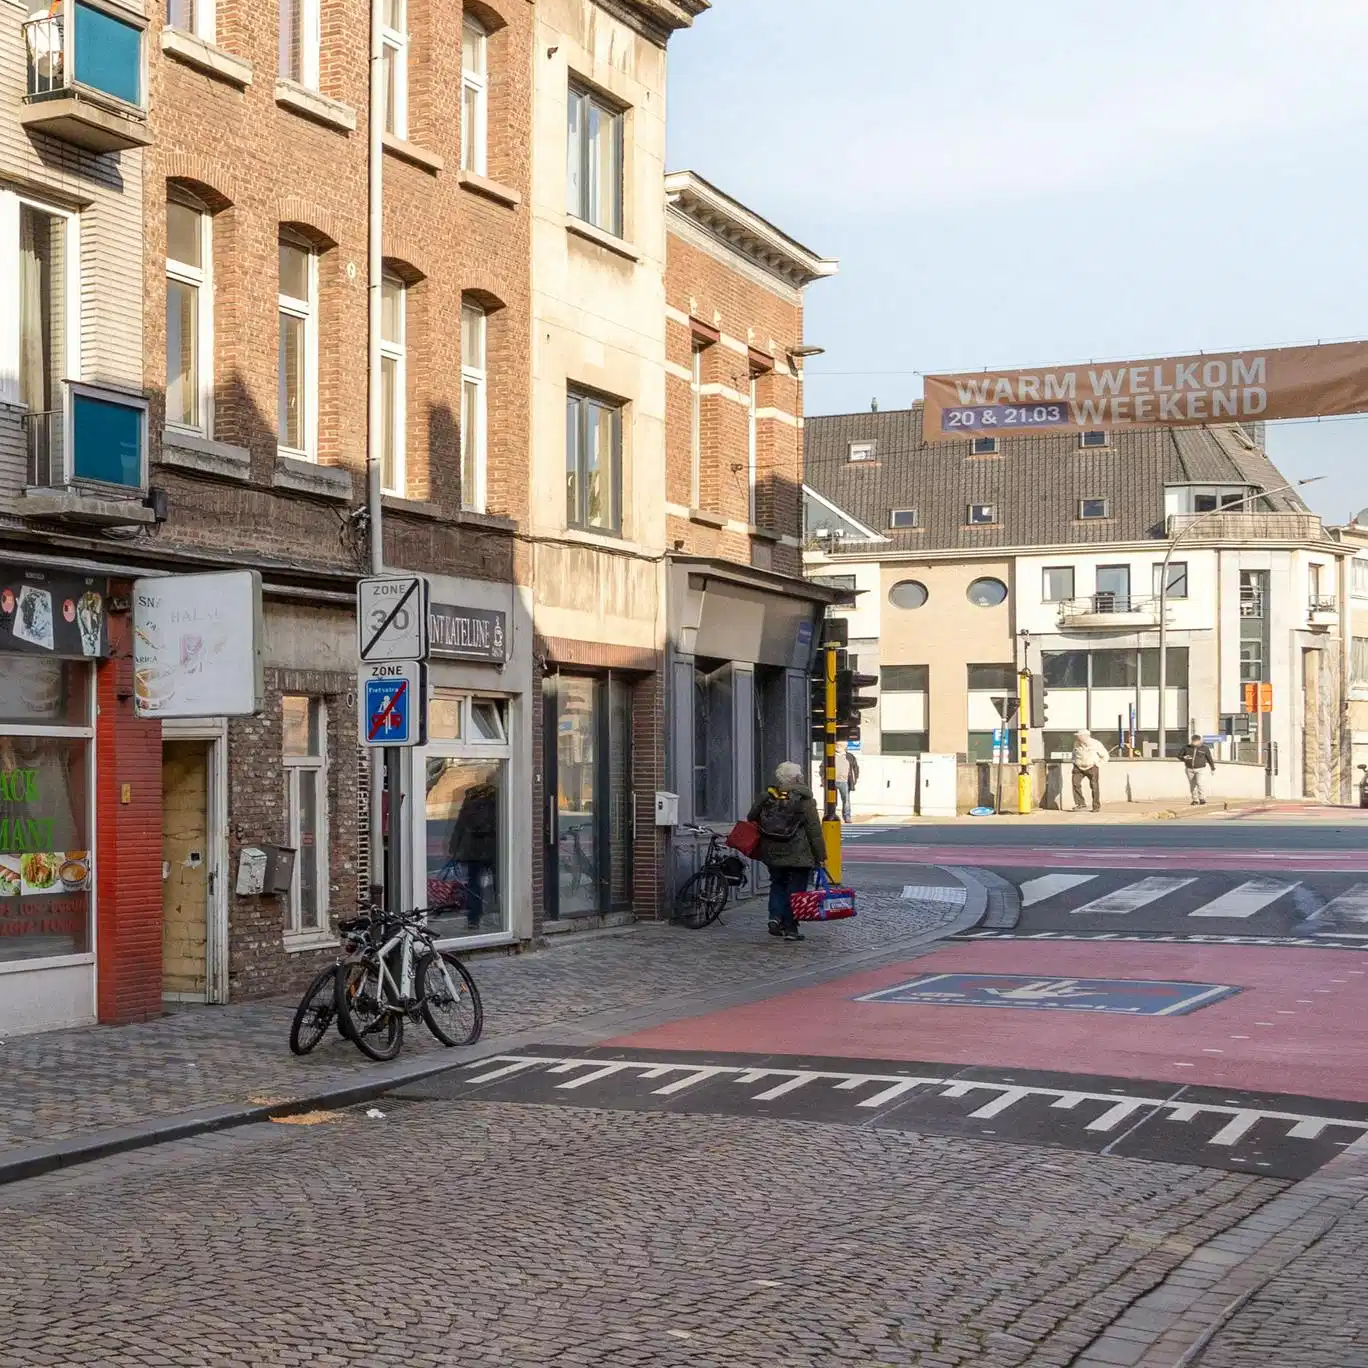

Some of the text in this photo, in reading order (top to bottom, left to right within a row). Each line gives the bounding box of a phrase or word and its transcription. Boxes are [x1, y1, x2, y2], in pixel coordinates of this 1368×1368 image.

[956, 357, 1266, 405] WARM WELKOM
[947, 405, 1061, 427] 20 & 21.03
[1070, 386, 1267, 427] WEEKEND
[373, 584, 407, 596] ZONE
[370, 608, 409, 631] 30
[372, 666, 403, 676] ZONE
